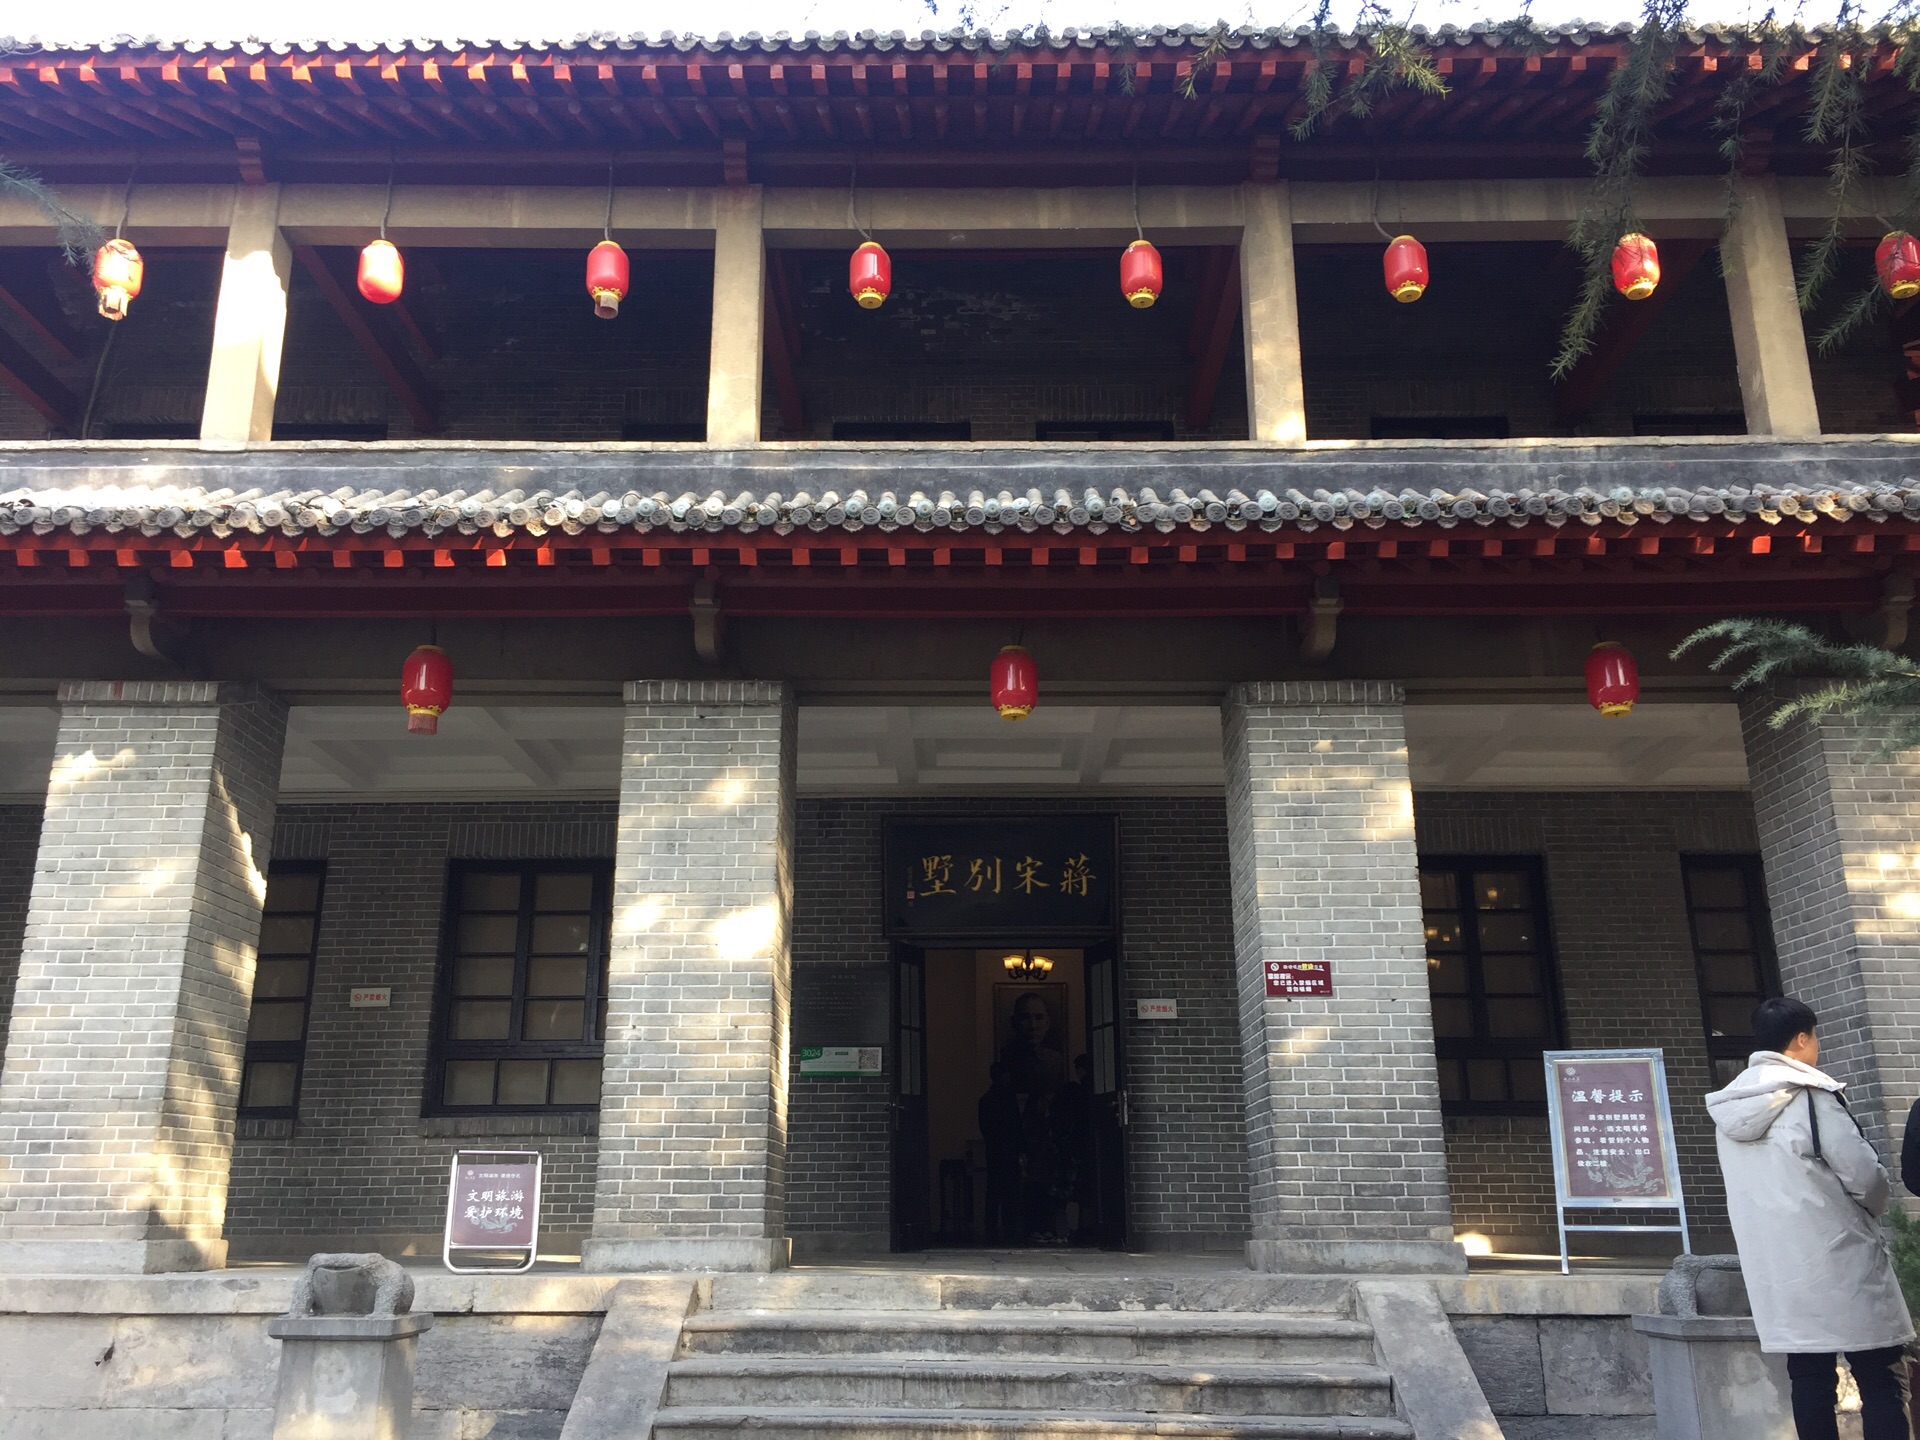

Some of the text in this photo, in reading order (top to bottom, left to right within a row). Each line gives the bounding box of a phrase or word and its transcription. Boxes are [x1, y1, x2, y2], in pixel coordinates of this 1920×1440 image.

[1150, 1005, 1174, 1013] 严禁烟火
[802, 1049, 821, 1057] 3024
[1571, 1088, 1644, 1104] 温馨提示
[466, 1189, 525, 1202] 文明旅游
[464, 1205, 524, 1220] 爱护环境
